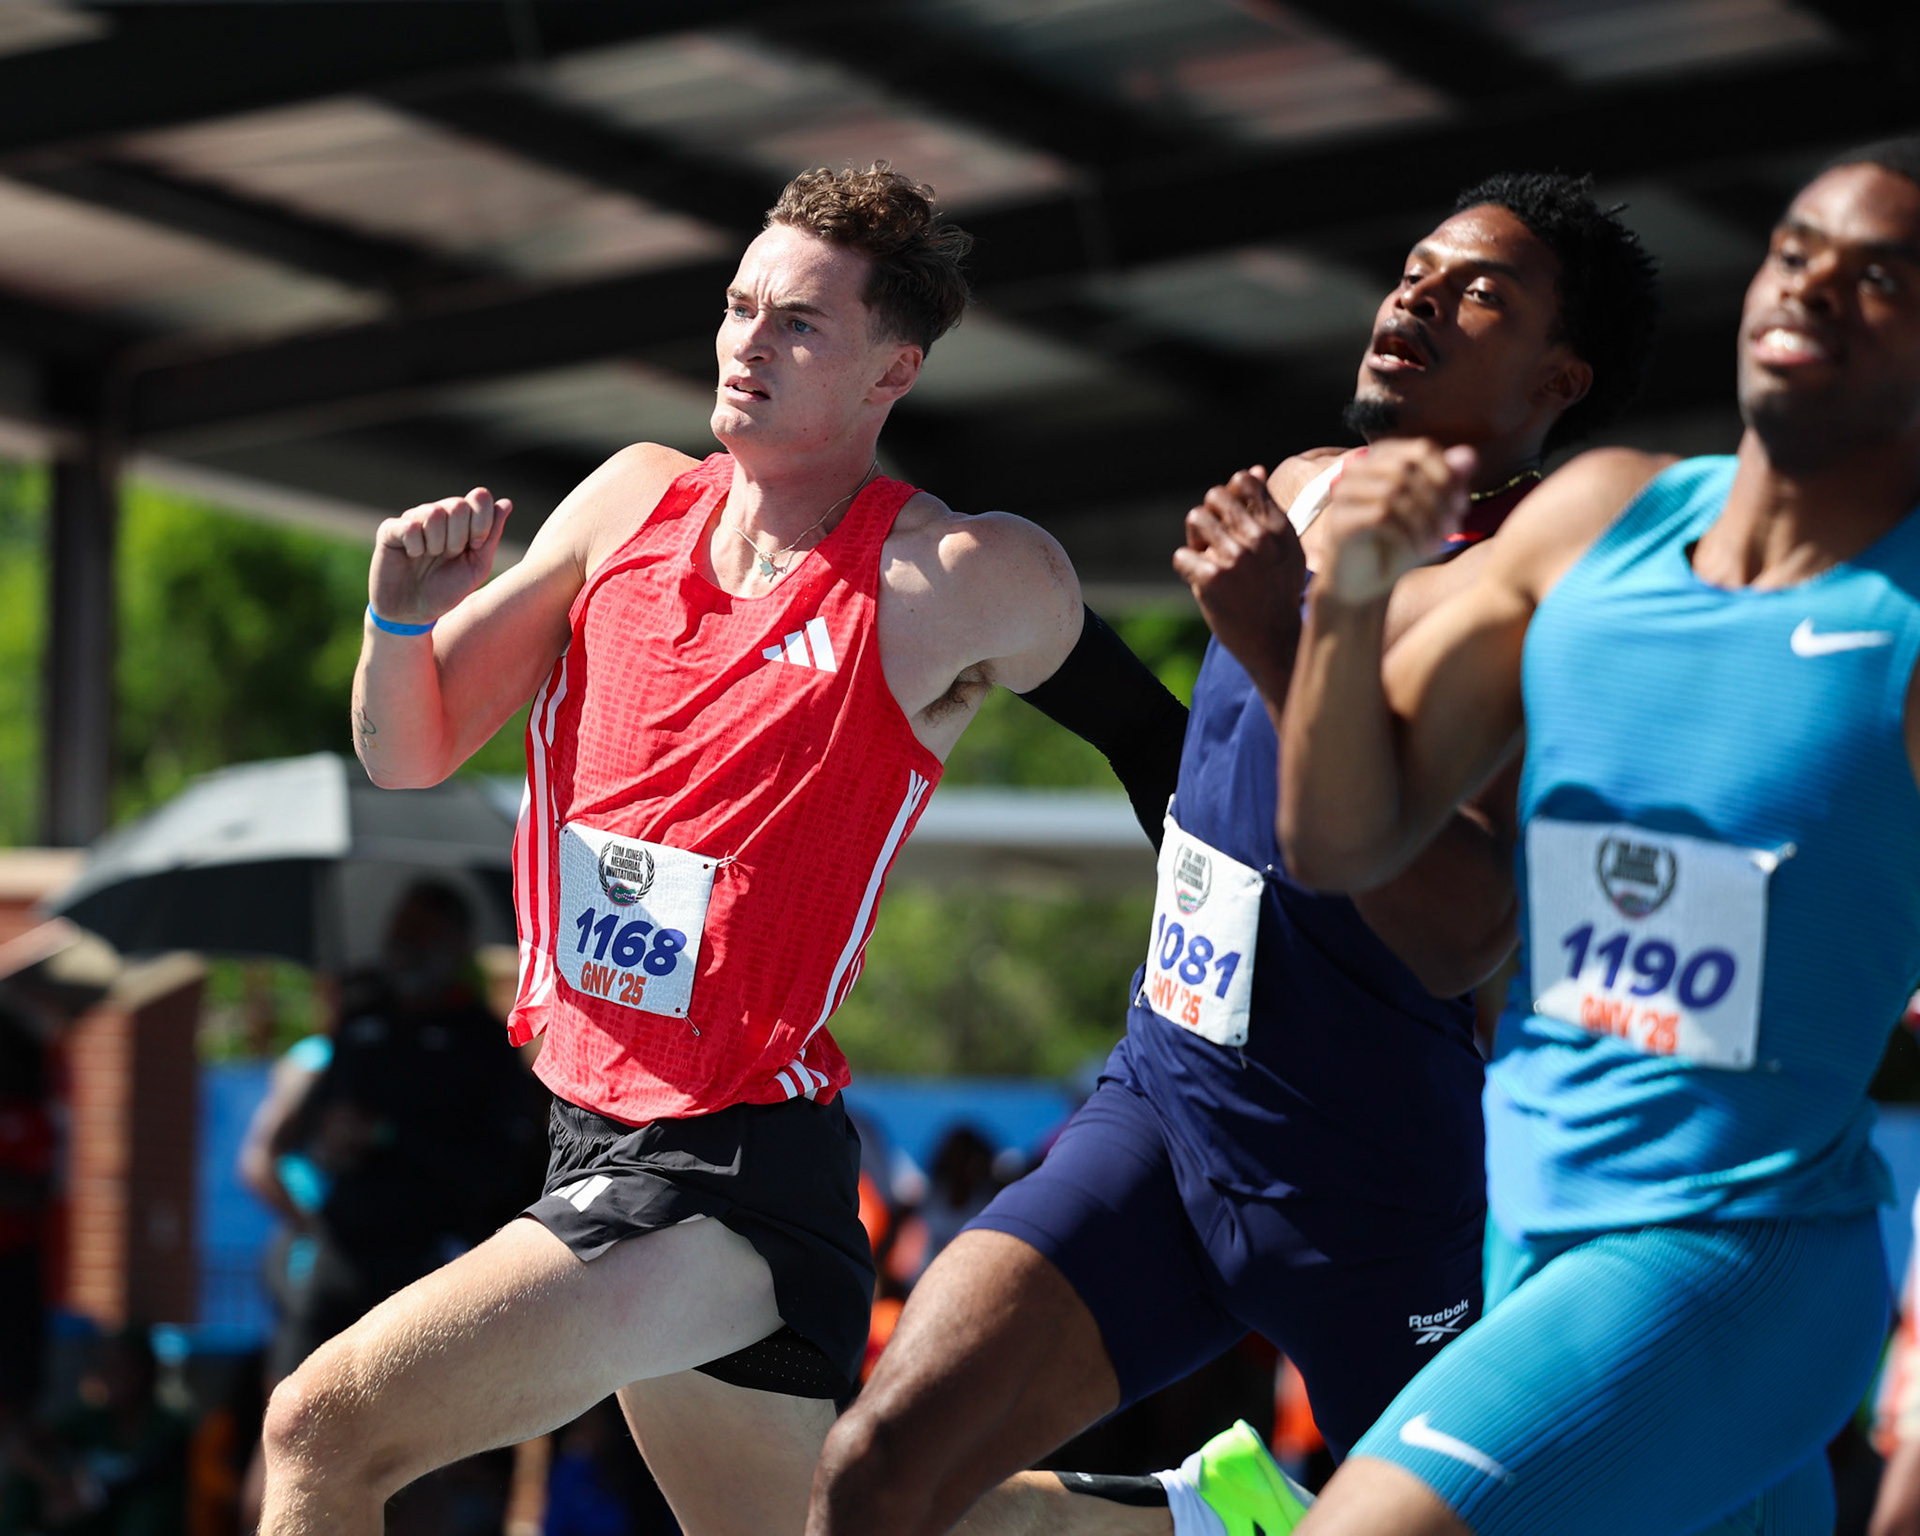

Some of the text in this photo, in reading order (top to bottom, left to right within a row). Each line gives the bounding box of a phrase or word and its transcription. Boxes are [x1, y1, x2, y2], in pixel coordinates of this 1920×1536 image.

[576, 907, 687, 976] 1168
[1562, 923, 1738, 1011] 1190
[581, 961, 617, 996] GNV
[1409, 1299, 1469, 1328] Reebok
